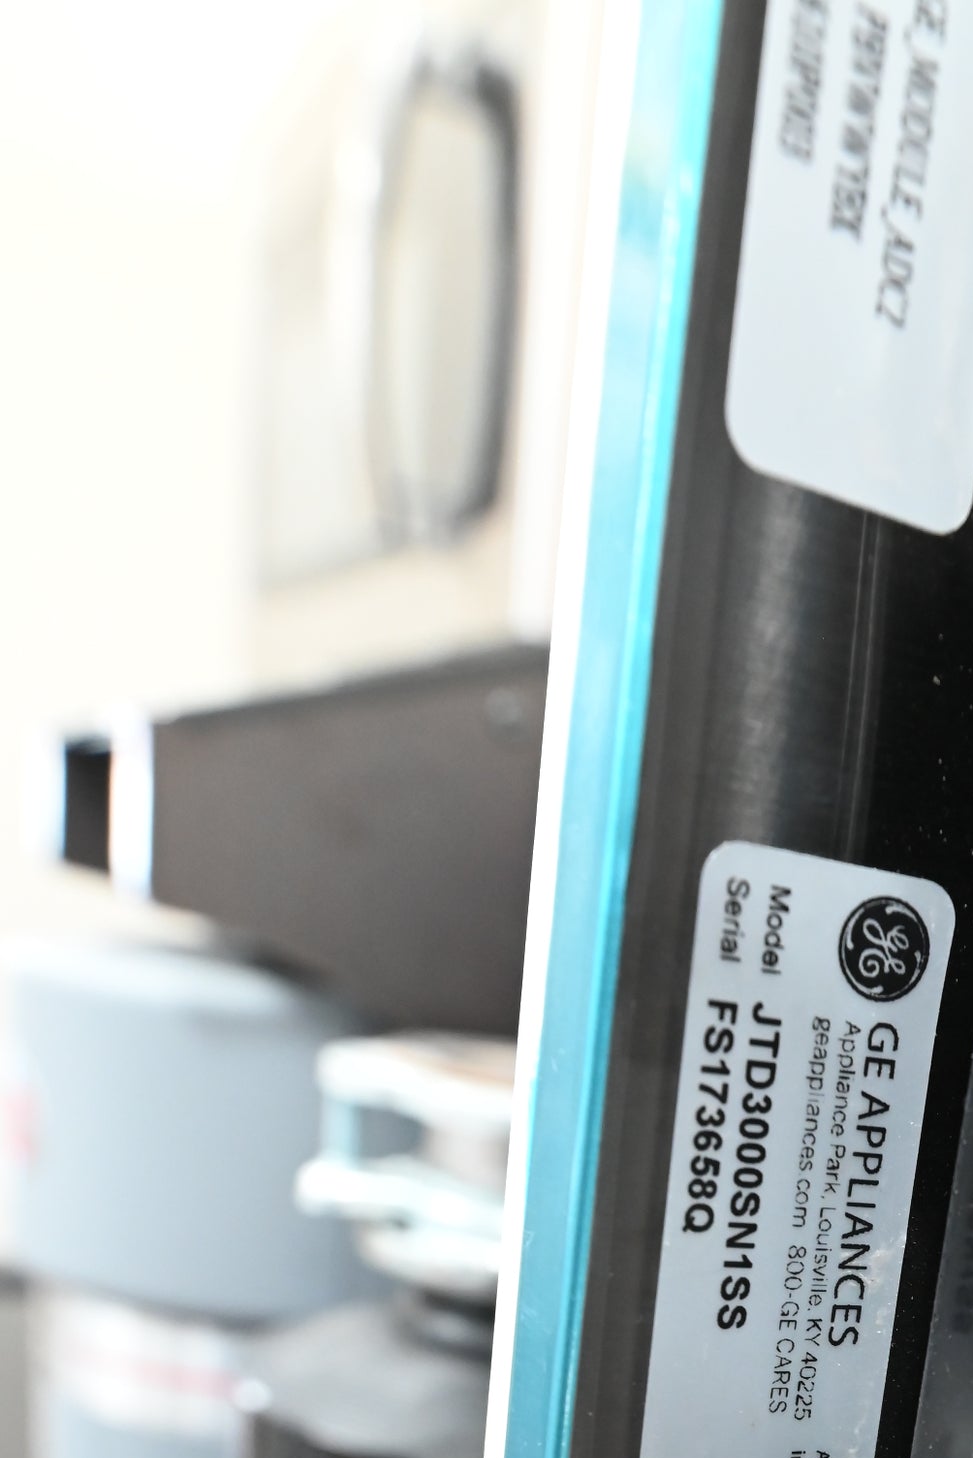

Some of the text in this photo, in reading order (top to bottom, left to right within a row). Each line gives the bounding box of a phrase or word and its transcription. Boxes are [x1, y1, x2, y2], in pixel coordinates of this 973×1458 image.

[682, 875, 750, 1233] Serial FS173658Q
[716, 883, 792, 1330] Model JTD3000SN1SS
[830, 1020, 862, 1138] Appliance
[768, 1016, 831, 1414] geappliances.com 800-GE CARES
[820, 1143, 846, 1200] Park,
[828, 1022, 899, 1347] GE APPLIANCES
[793, 1351, 819, 1421] 40225
[804, 1317, 823, 1348] KY
